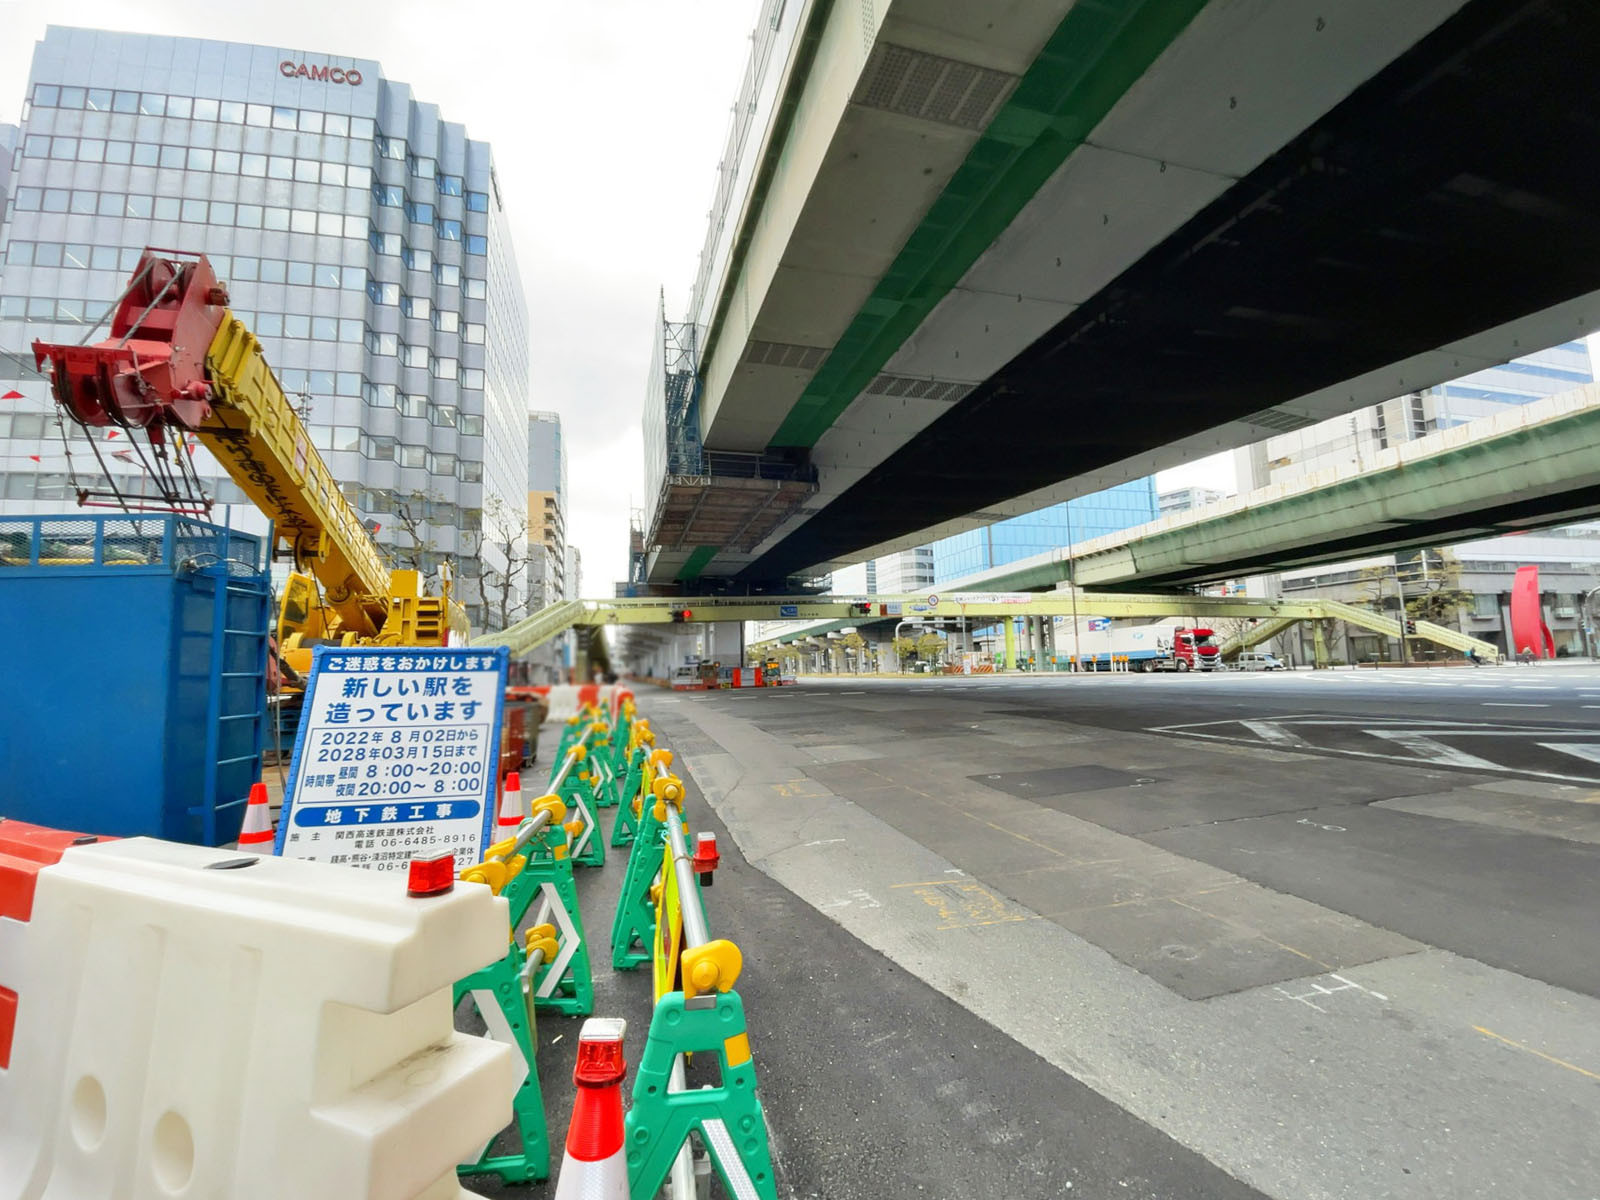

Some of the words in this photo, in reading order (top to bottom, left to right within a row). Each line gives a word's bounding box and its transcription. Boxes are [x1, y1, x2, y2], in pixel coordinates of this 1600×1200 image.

[279, 61, 363, 86] CAMCO
[328, 656, 496, 671] ご迷惑をおかけします
[342, 676, 472, 698] 新しい駅を
[324, 700, 482, 724] 造っています
[317, 745, 477, 762] 2028年03月15日まで
[338, 766, 358, 779] 昼間
[304, 774, 335, 788] 時間帯
[336, 783, 356, 797] 夜間
[324, 803, 453, 824] 地下鉄工事
[335, 826, 434, 841] 関西高速鉄道株式会社
[354, 840, 375, 849] 電話
[381, 834, 476, 847] 06-6485-8916
